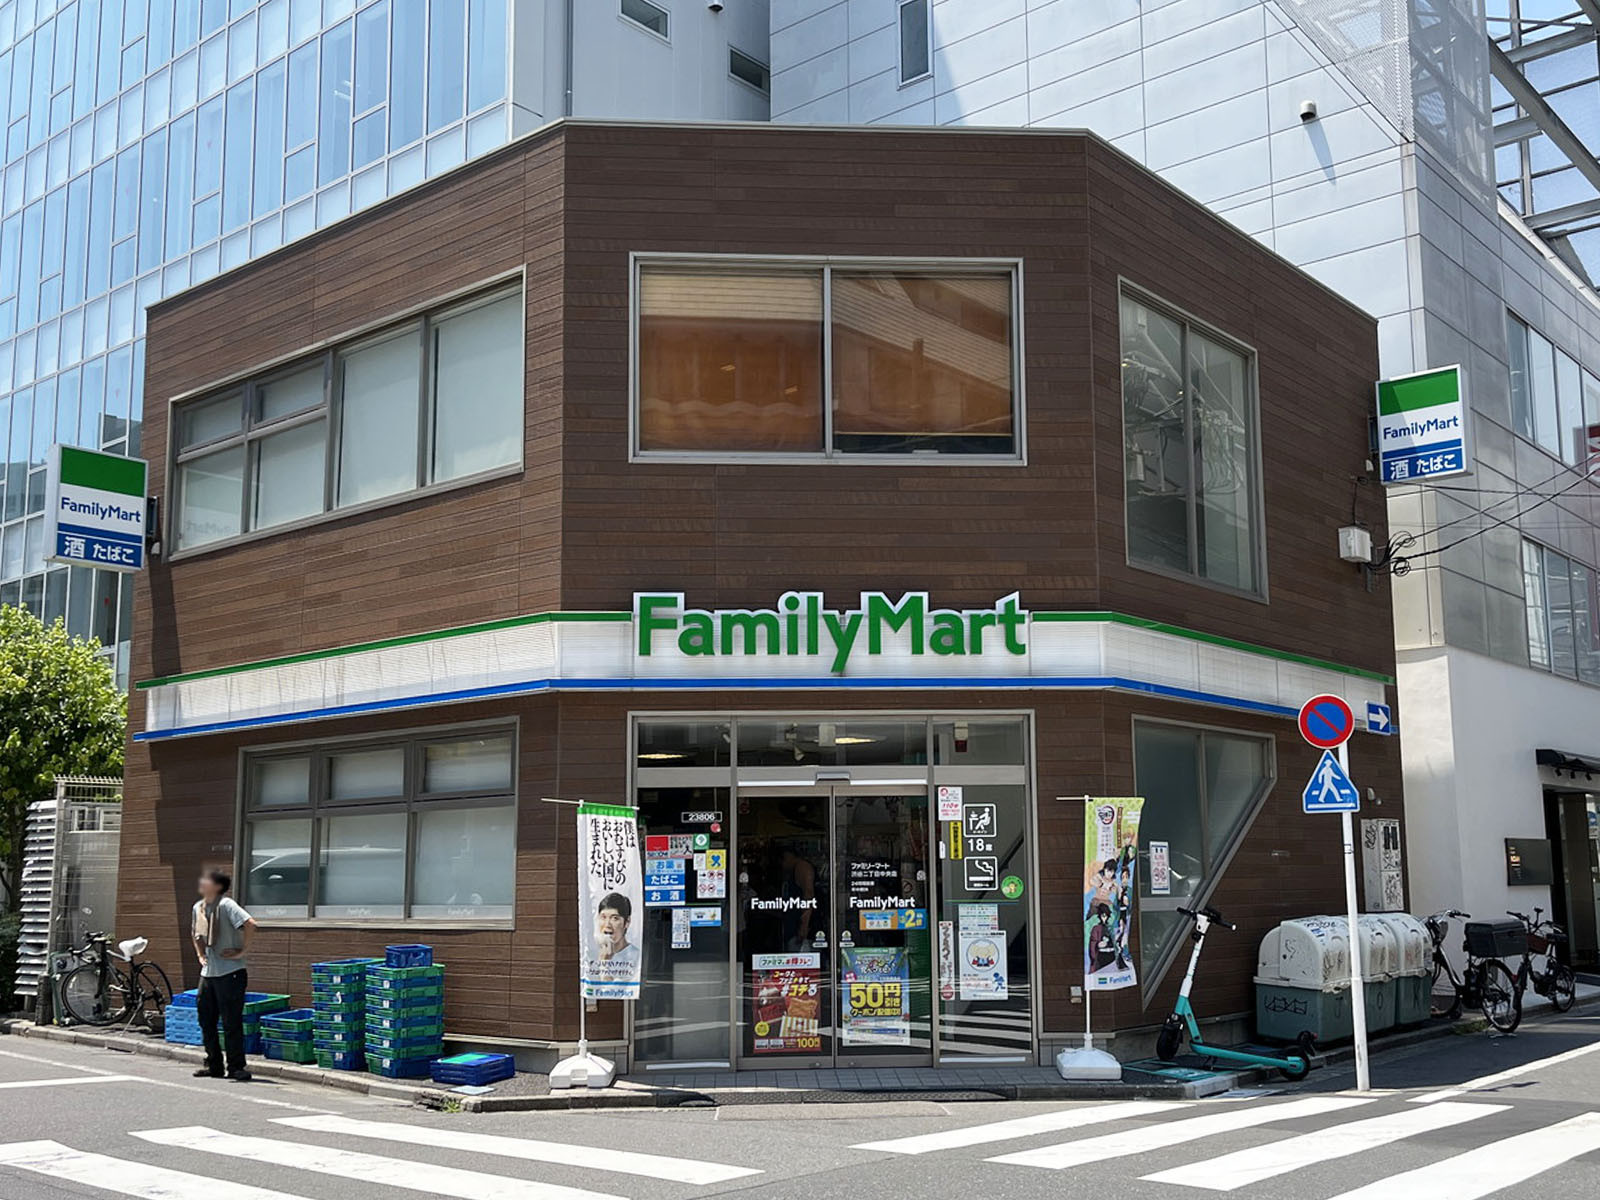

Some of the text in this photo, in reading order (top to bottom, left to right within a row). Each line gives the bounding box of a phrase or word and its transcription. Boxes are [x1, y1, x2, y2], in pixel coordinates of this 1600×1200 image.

[1383, 415, 1459, 440] FamilyMart
[1390, 454, 1457, 479] 酒 たばこ
[60, 496, 141, 523] FamilyMart
[64, 536, 135, 563] 酒 たばこ
[634, 592, 1029, 674] FamilyMart
[688, 813, 715, 821] 23806
[590, 818, 603, 878] 生まれた。
[601, 819, 615, 891] おいしい国に
[613, 820, 626, 886] おむすびの
[651, 875, 679, 885] たばこ
[751, 897, 817, 912] FamilyMart
[849, 895, 916, 911] FamilyMart
